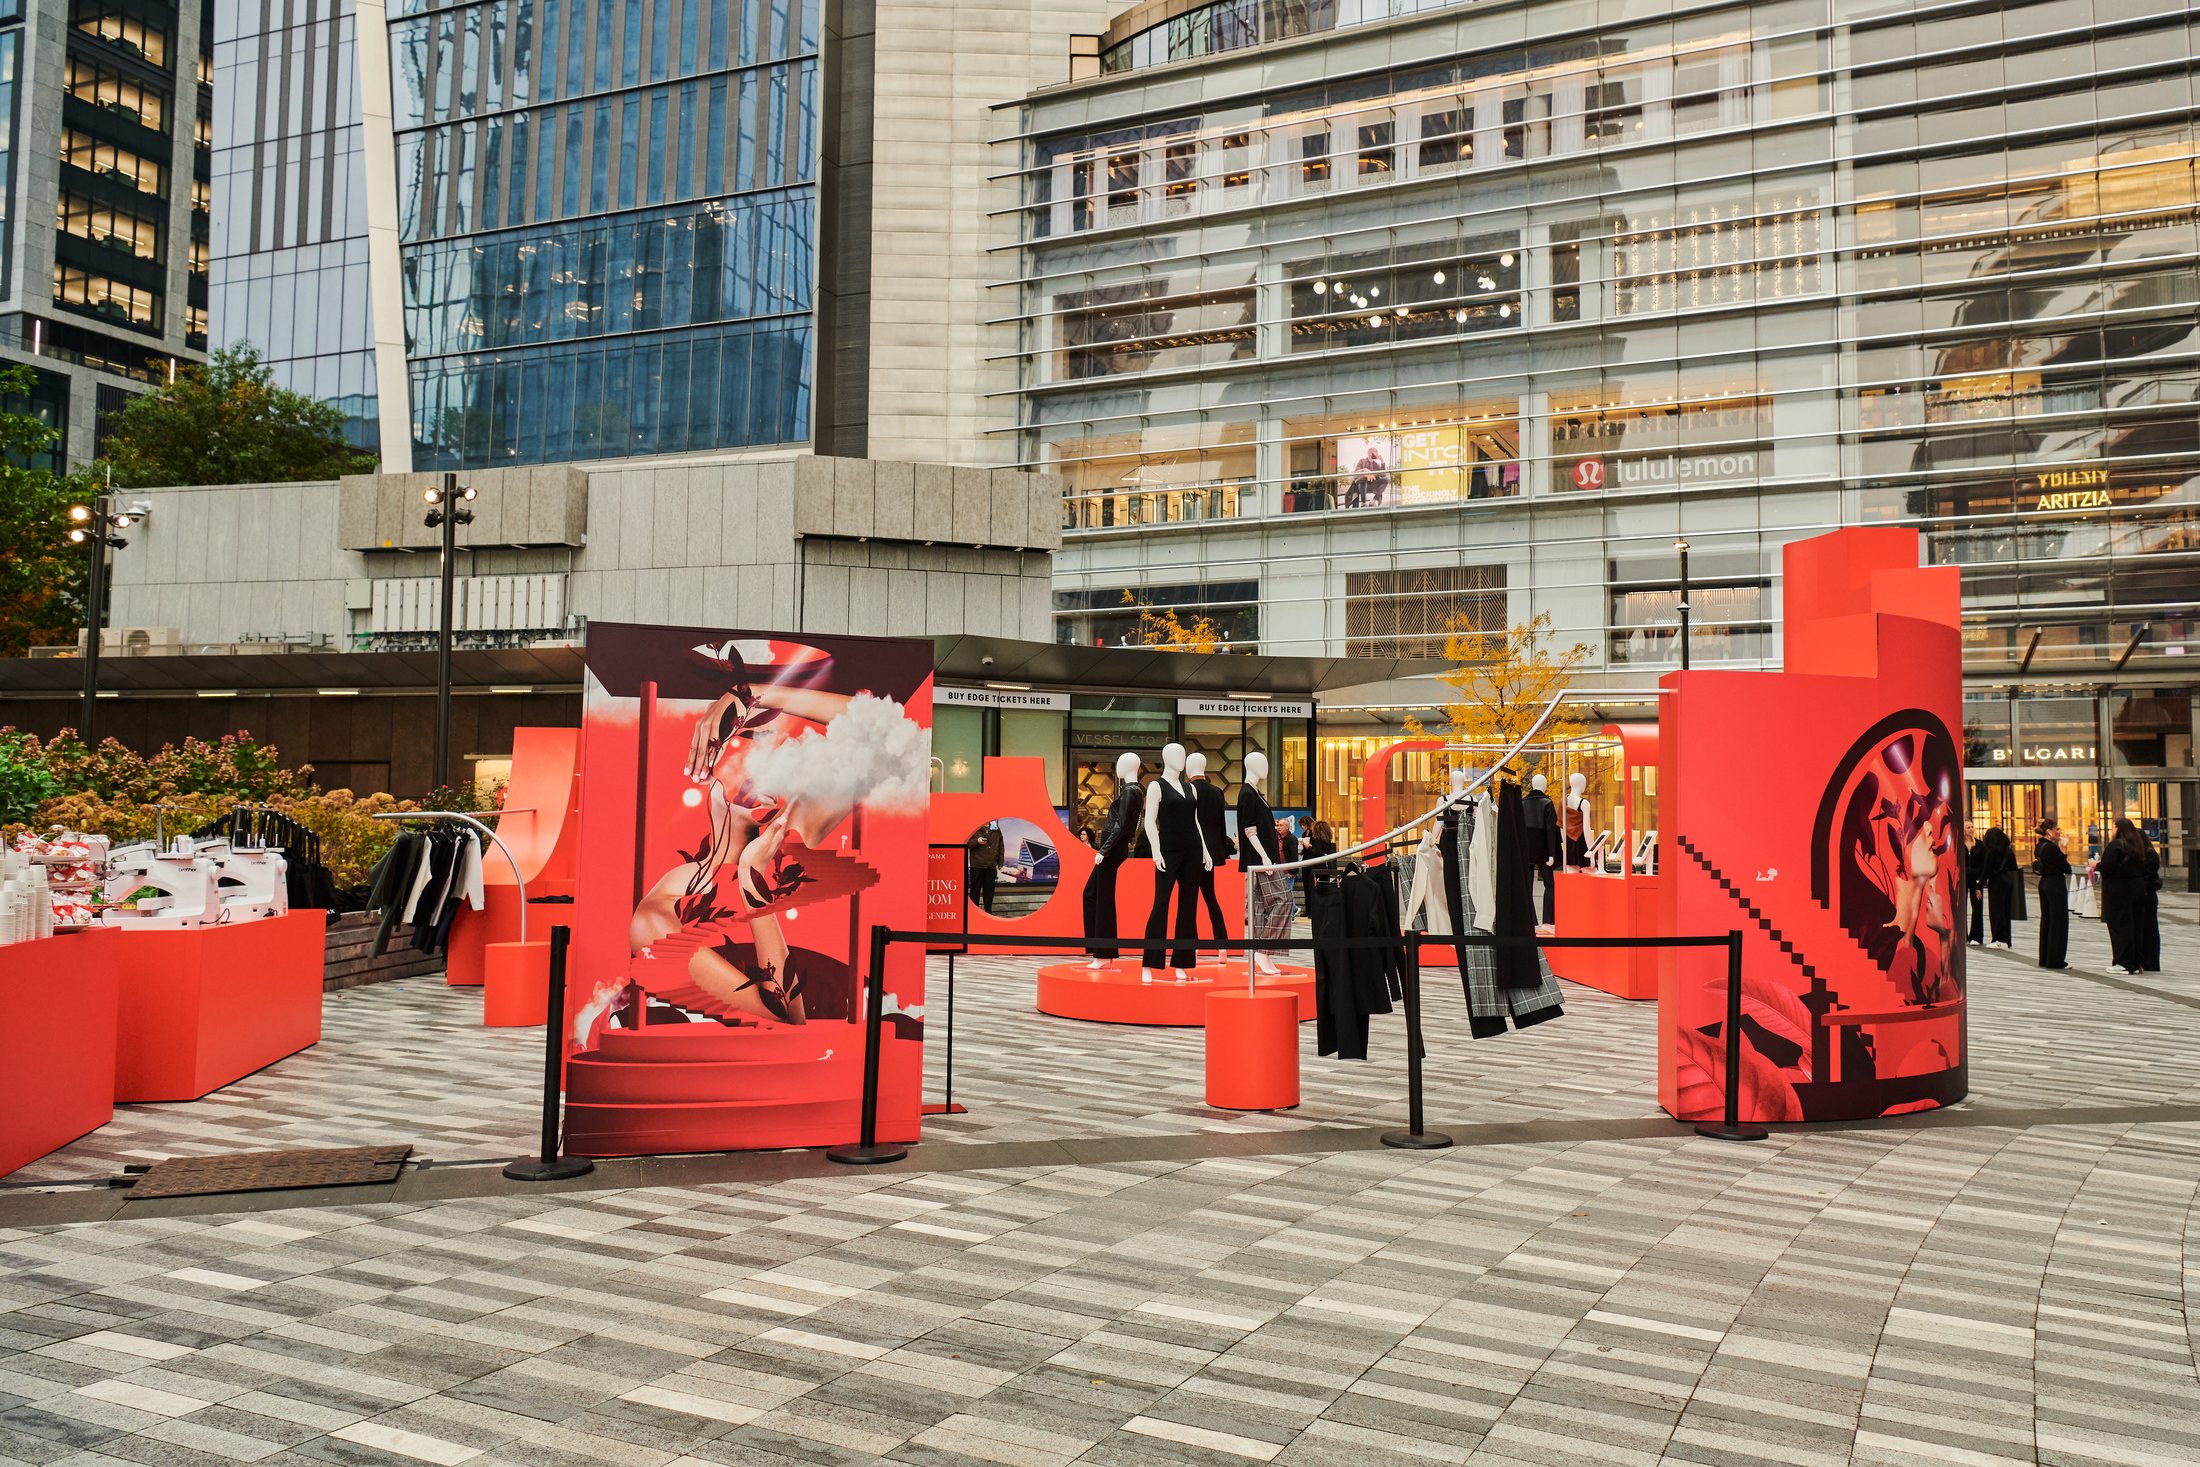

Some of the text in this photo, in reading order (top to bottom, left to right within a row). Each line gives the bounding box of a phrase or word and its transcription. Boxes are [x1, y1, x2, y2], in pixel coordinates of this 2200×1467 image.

[1402, 432, 1440, 449] GET
[1403, 445, 1466, 463] INTO
[1617, 454, 1754, 483] lululemon
[2036, 489, 2113, 511] ARITZIA
[948, 691, 1051, 705] BUY EDGE TICKETS HERE
[1199, 703, 1302, 714] BUY EDGE TICKETS HERE
[1076, 734, 1127, 745] VESSEL
[927, 879, 957, 891] TING
